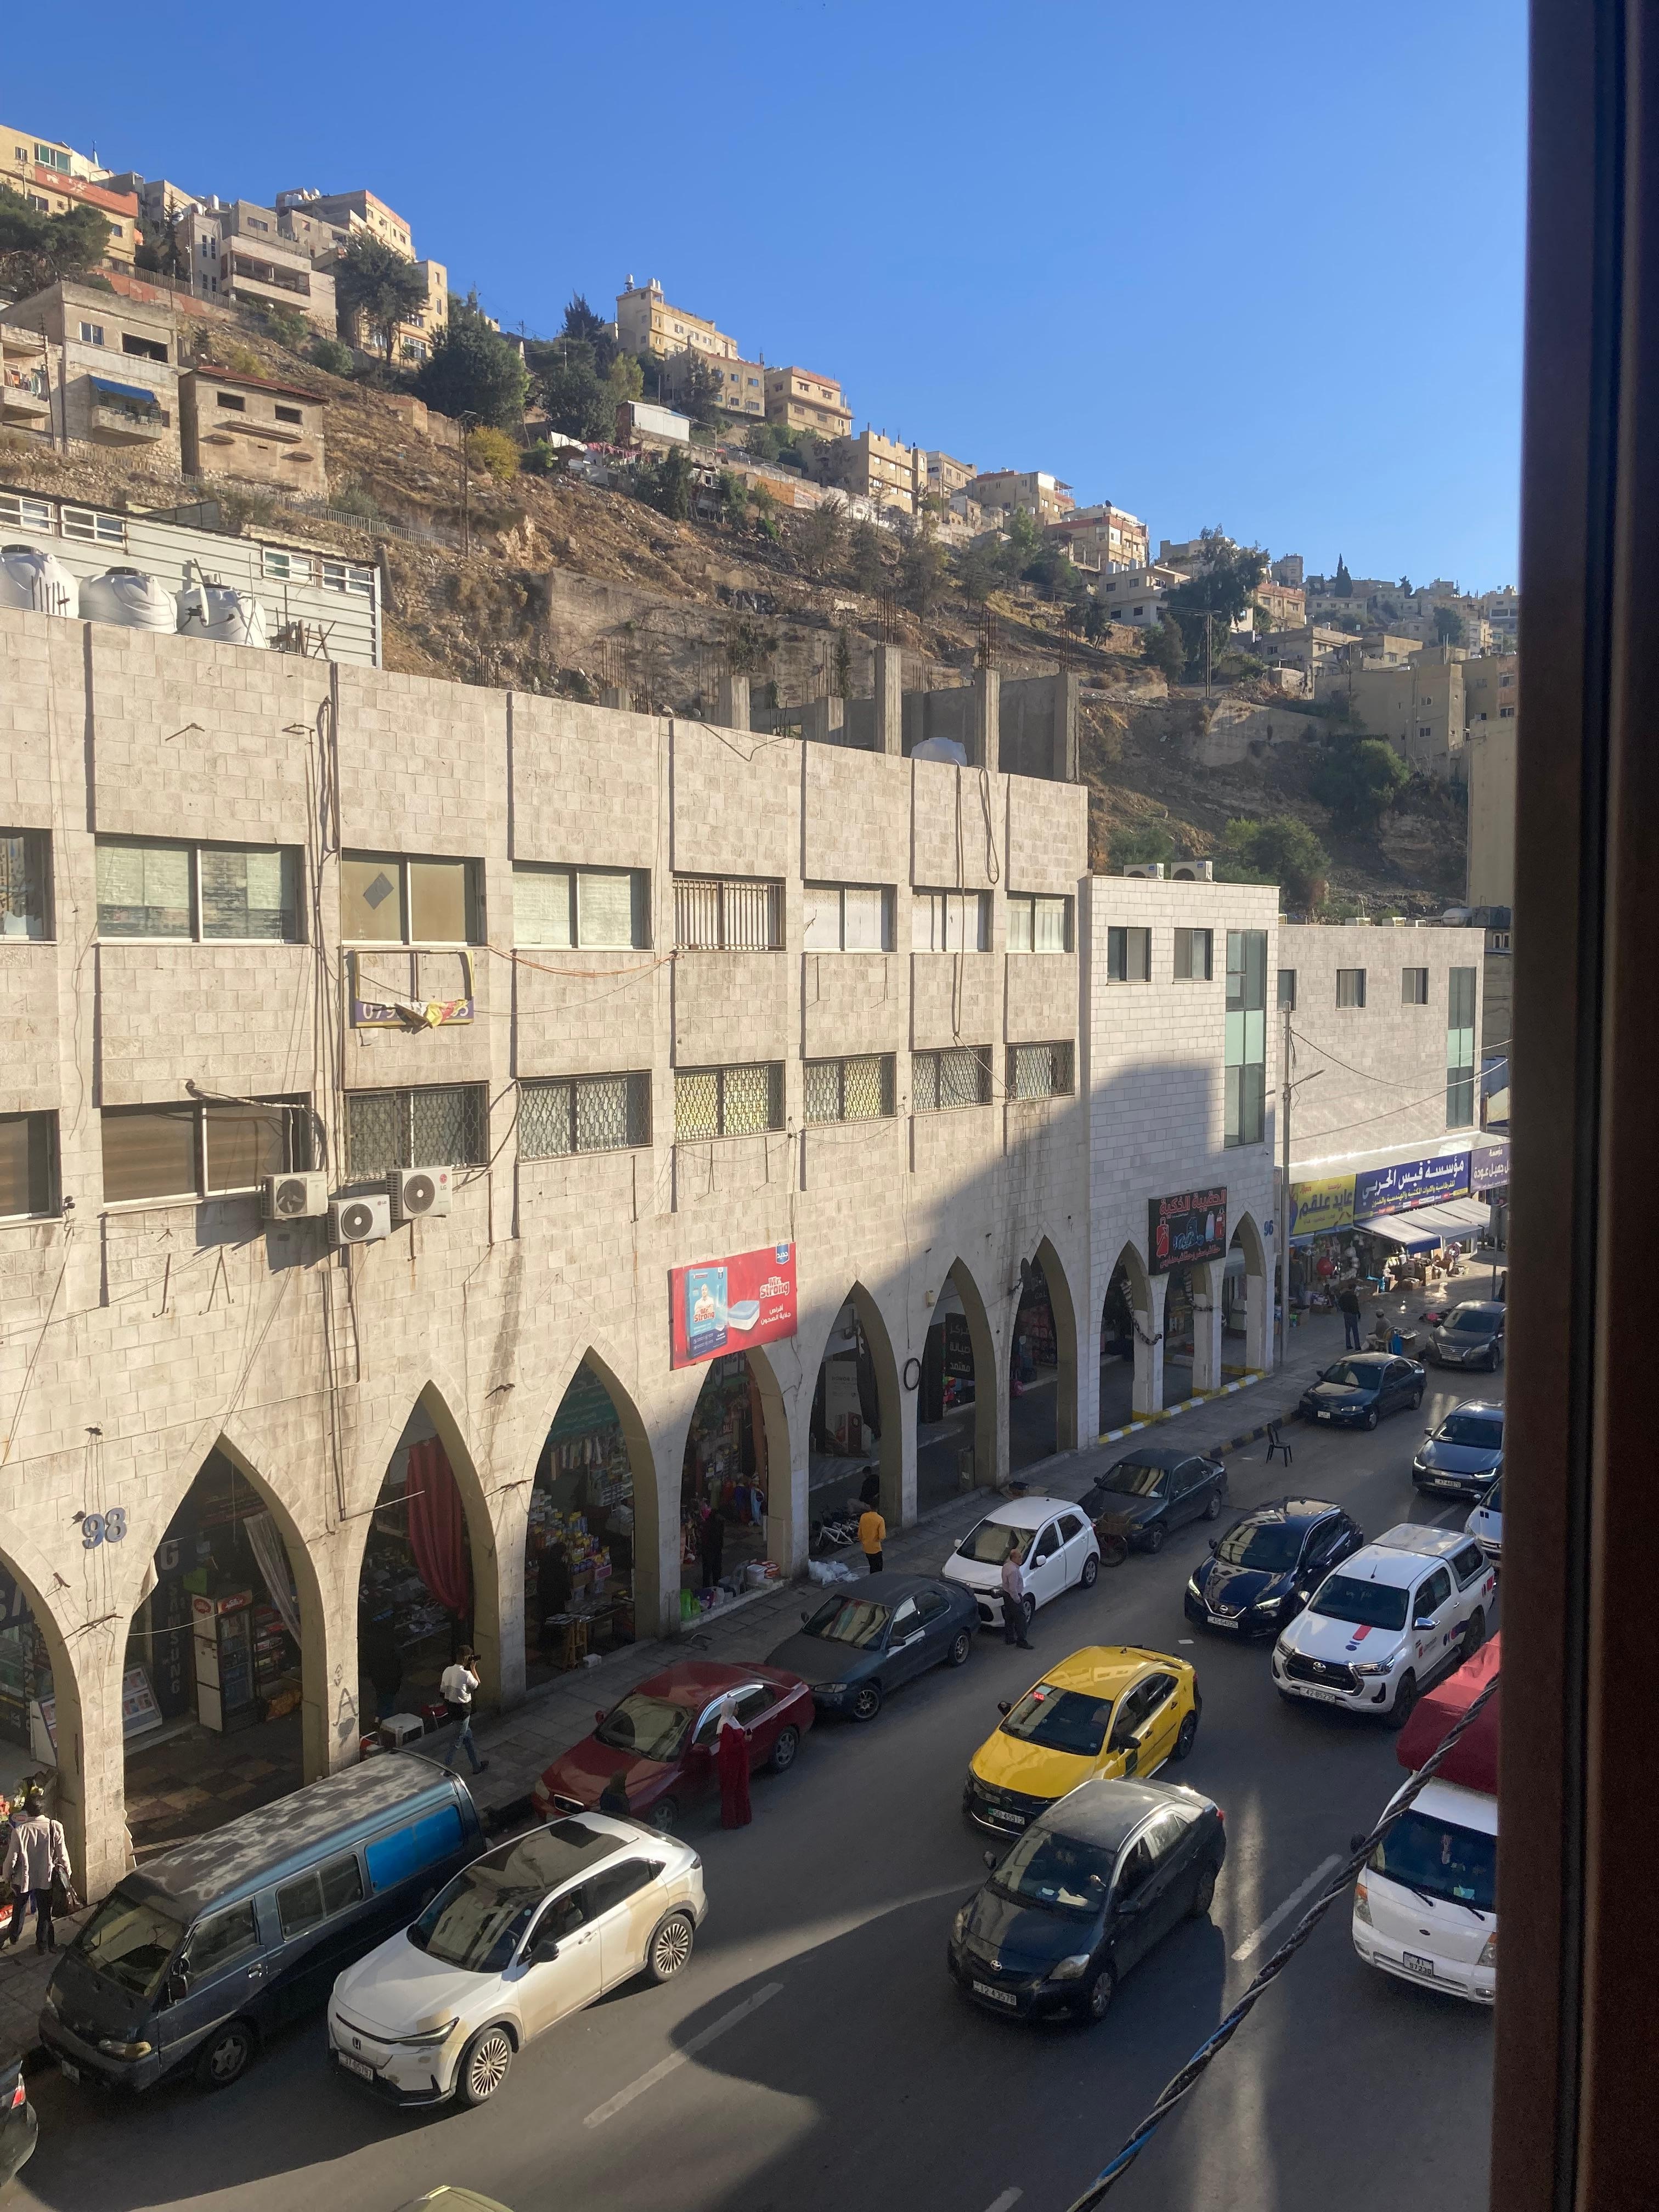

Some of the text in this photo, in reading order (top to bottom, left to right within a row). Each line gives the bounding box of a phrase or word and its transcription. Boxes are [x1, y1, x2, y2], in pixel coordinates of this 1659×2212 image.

[1425, 1155, 1464, 1178] مؤسسة
[1264, 1220, 1273, 1237] 96
[760, 1282, 789, 1298] Strong
[694, 1312, 715, 1322] Strong
[82, 1508, 127, 1549] 98
